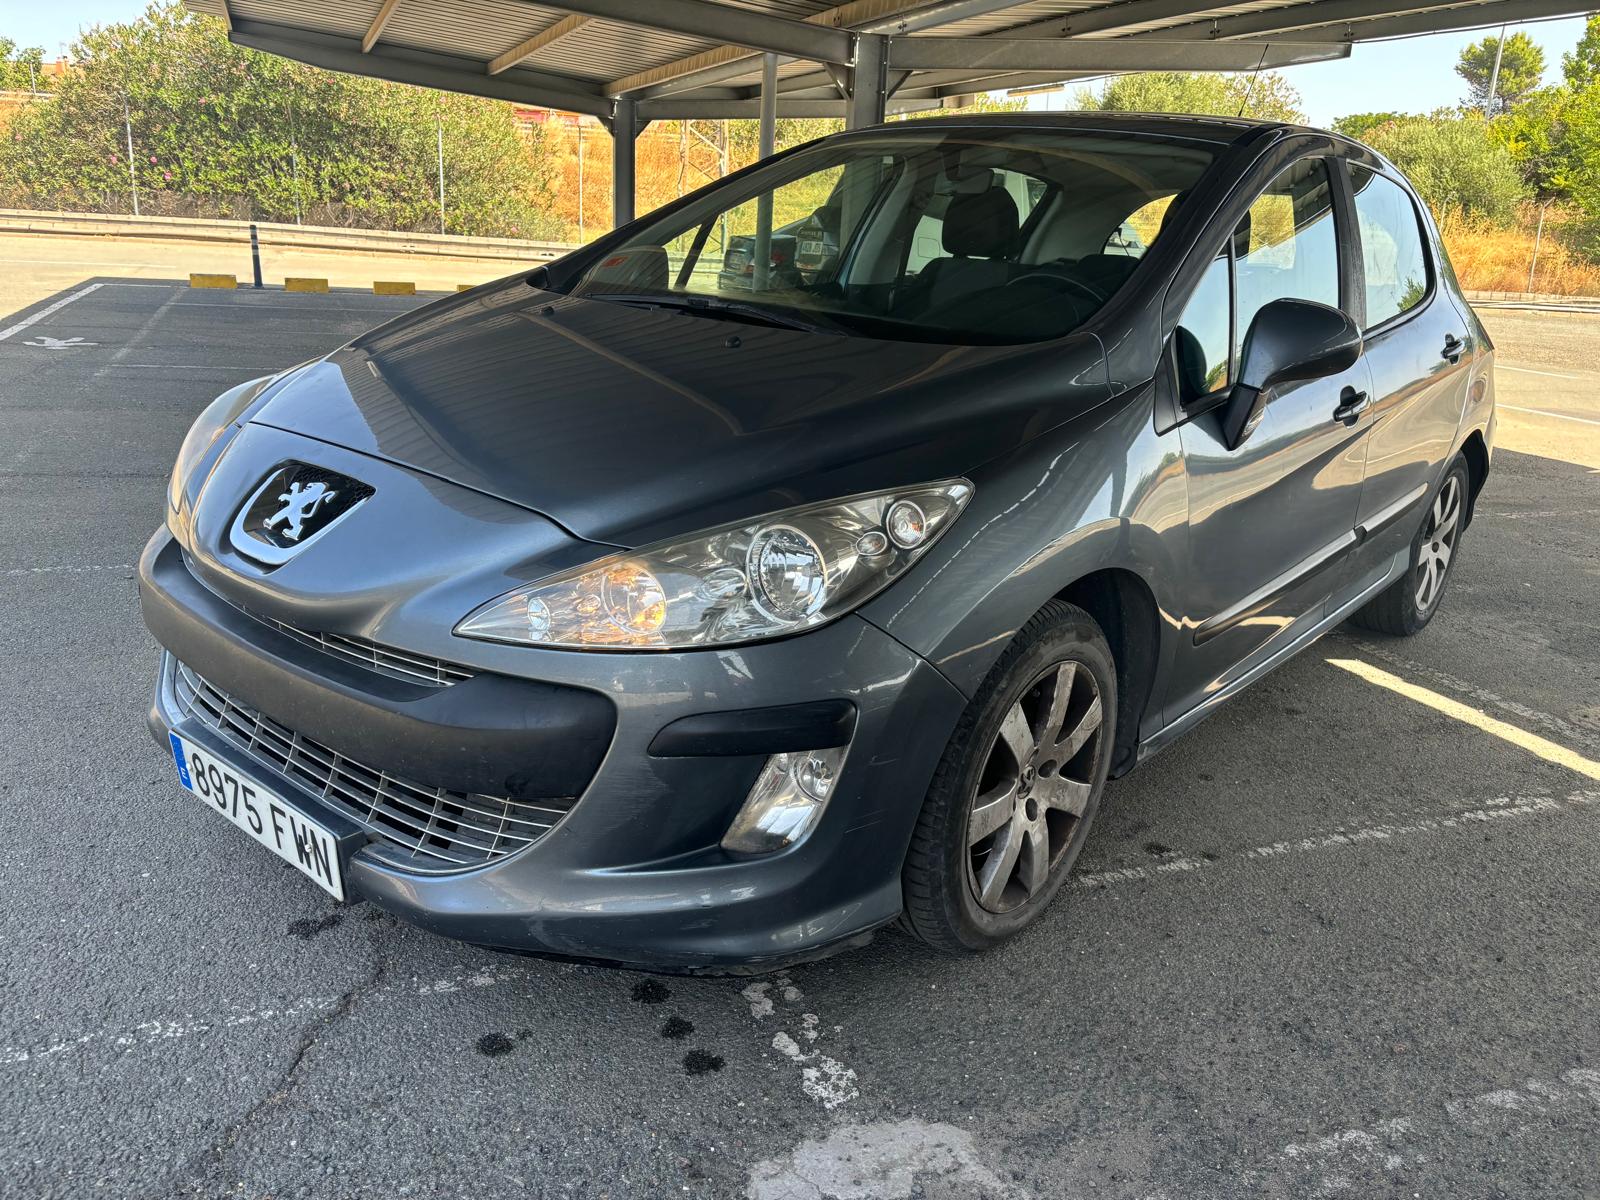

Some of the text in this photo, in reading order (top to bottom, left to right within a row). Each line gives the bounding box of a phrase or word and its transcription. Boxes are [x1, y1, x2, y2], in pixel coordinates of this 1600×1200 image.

[181, 767, 188, 779] E
[193, 752, 333, 887] 8975 FWN
